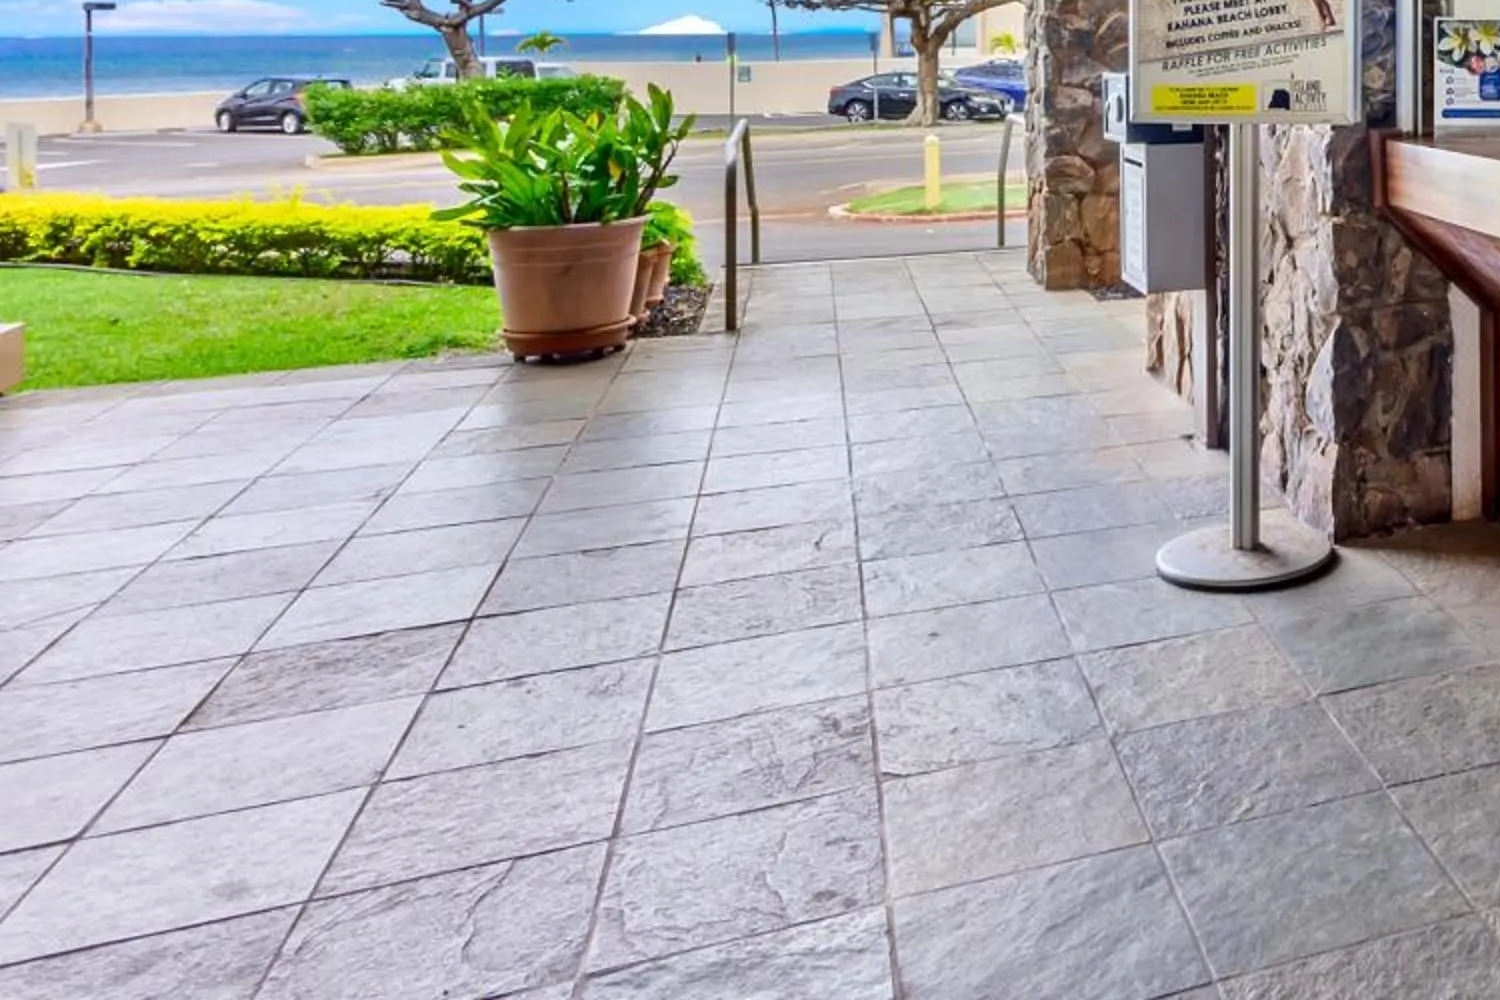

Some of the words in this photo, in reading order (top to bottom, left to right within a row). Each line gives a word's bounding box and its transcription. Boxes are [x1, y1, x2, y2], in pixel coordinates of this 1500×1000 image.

[1167, 18, 1213, 33] KAHANA
[1217, 11, 1252, 25] BEACH
[1255, 4, 1287, 18] LOBBY
[1183, 1, 1220, 17] PLEASE
[1165, 36, 1206, 49] INCLUDES
[1208, 30, 1240, 43] COFFEE
[1242, 26, 1261, 37] AND
[1161, 55, 1205, 72] RAFFLE
[1207, 52, 1232, 65] FOR
[1235, 47, 1261, 60] FREE
[1265, 36, 1328, 56] ACTIVITIES
